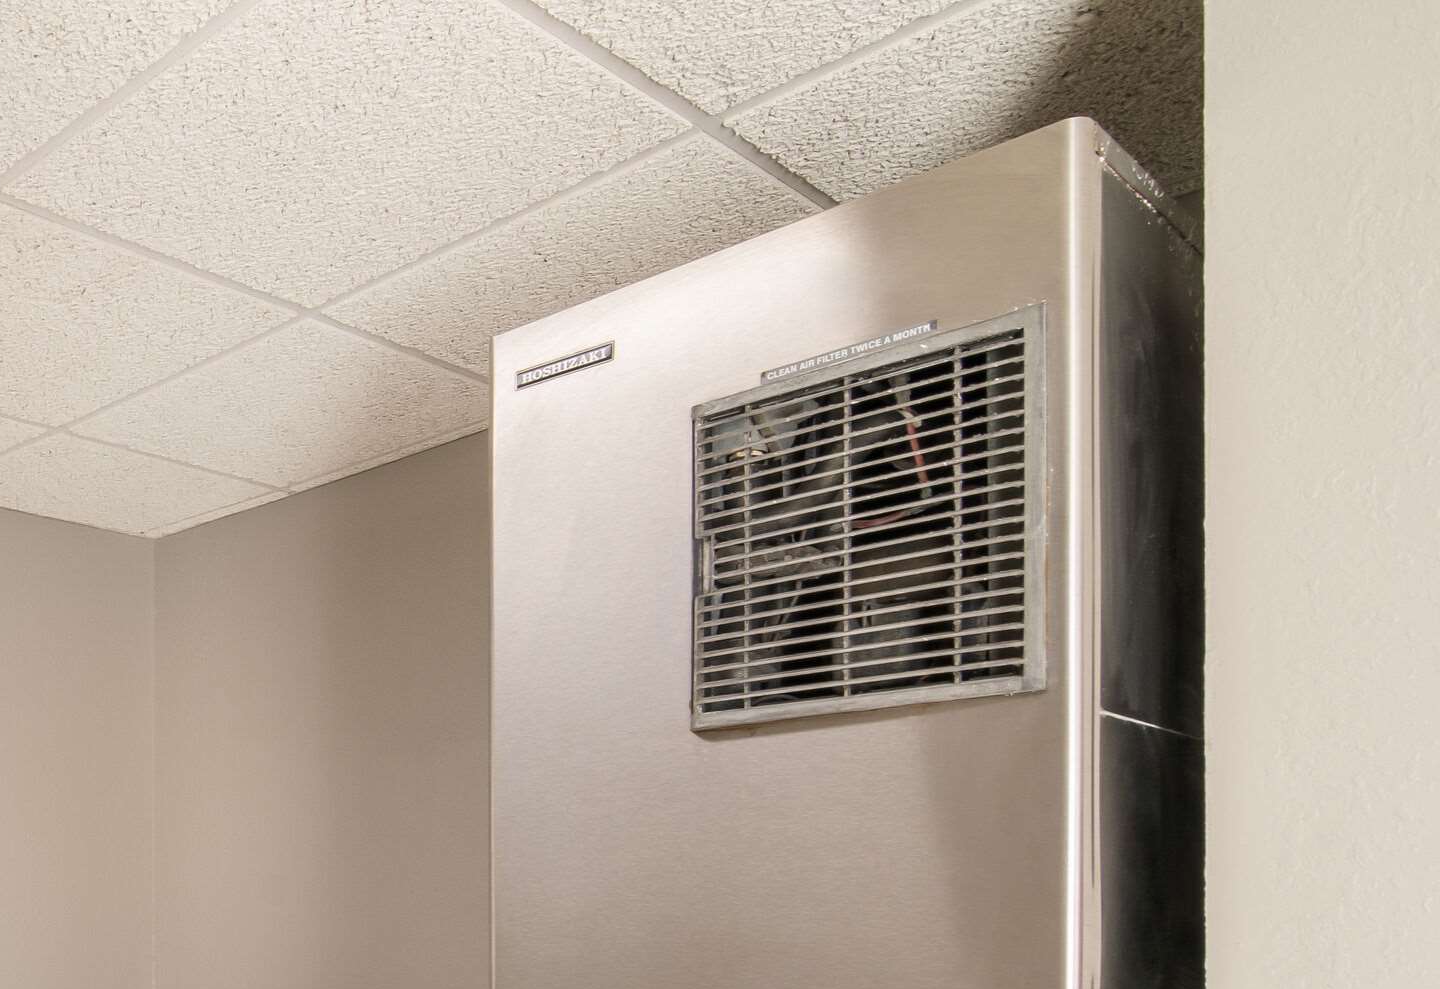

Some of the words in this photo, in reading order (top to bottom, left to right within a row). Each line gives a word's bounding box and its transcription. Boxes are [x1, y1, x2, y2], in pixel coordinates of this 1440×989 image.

[521, 349, 607, 383] HOSHIZAKI
[767, 366, 797, 380] CLEAN
[799, 359, 815, 371] AIR
[816, 349, 848, 366] FILTER
[850, 339, 882, 354] TWICE
[883, 336, 891, 345] A
[893, 323, 930, 342] MONTH
